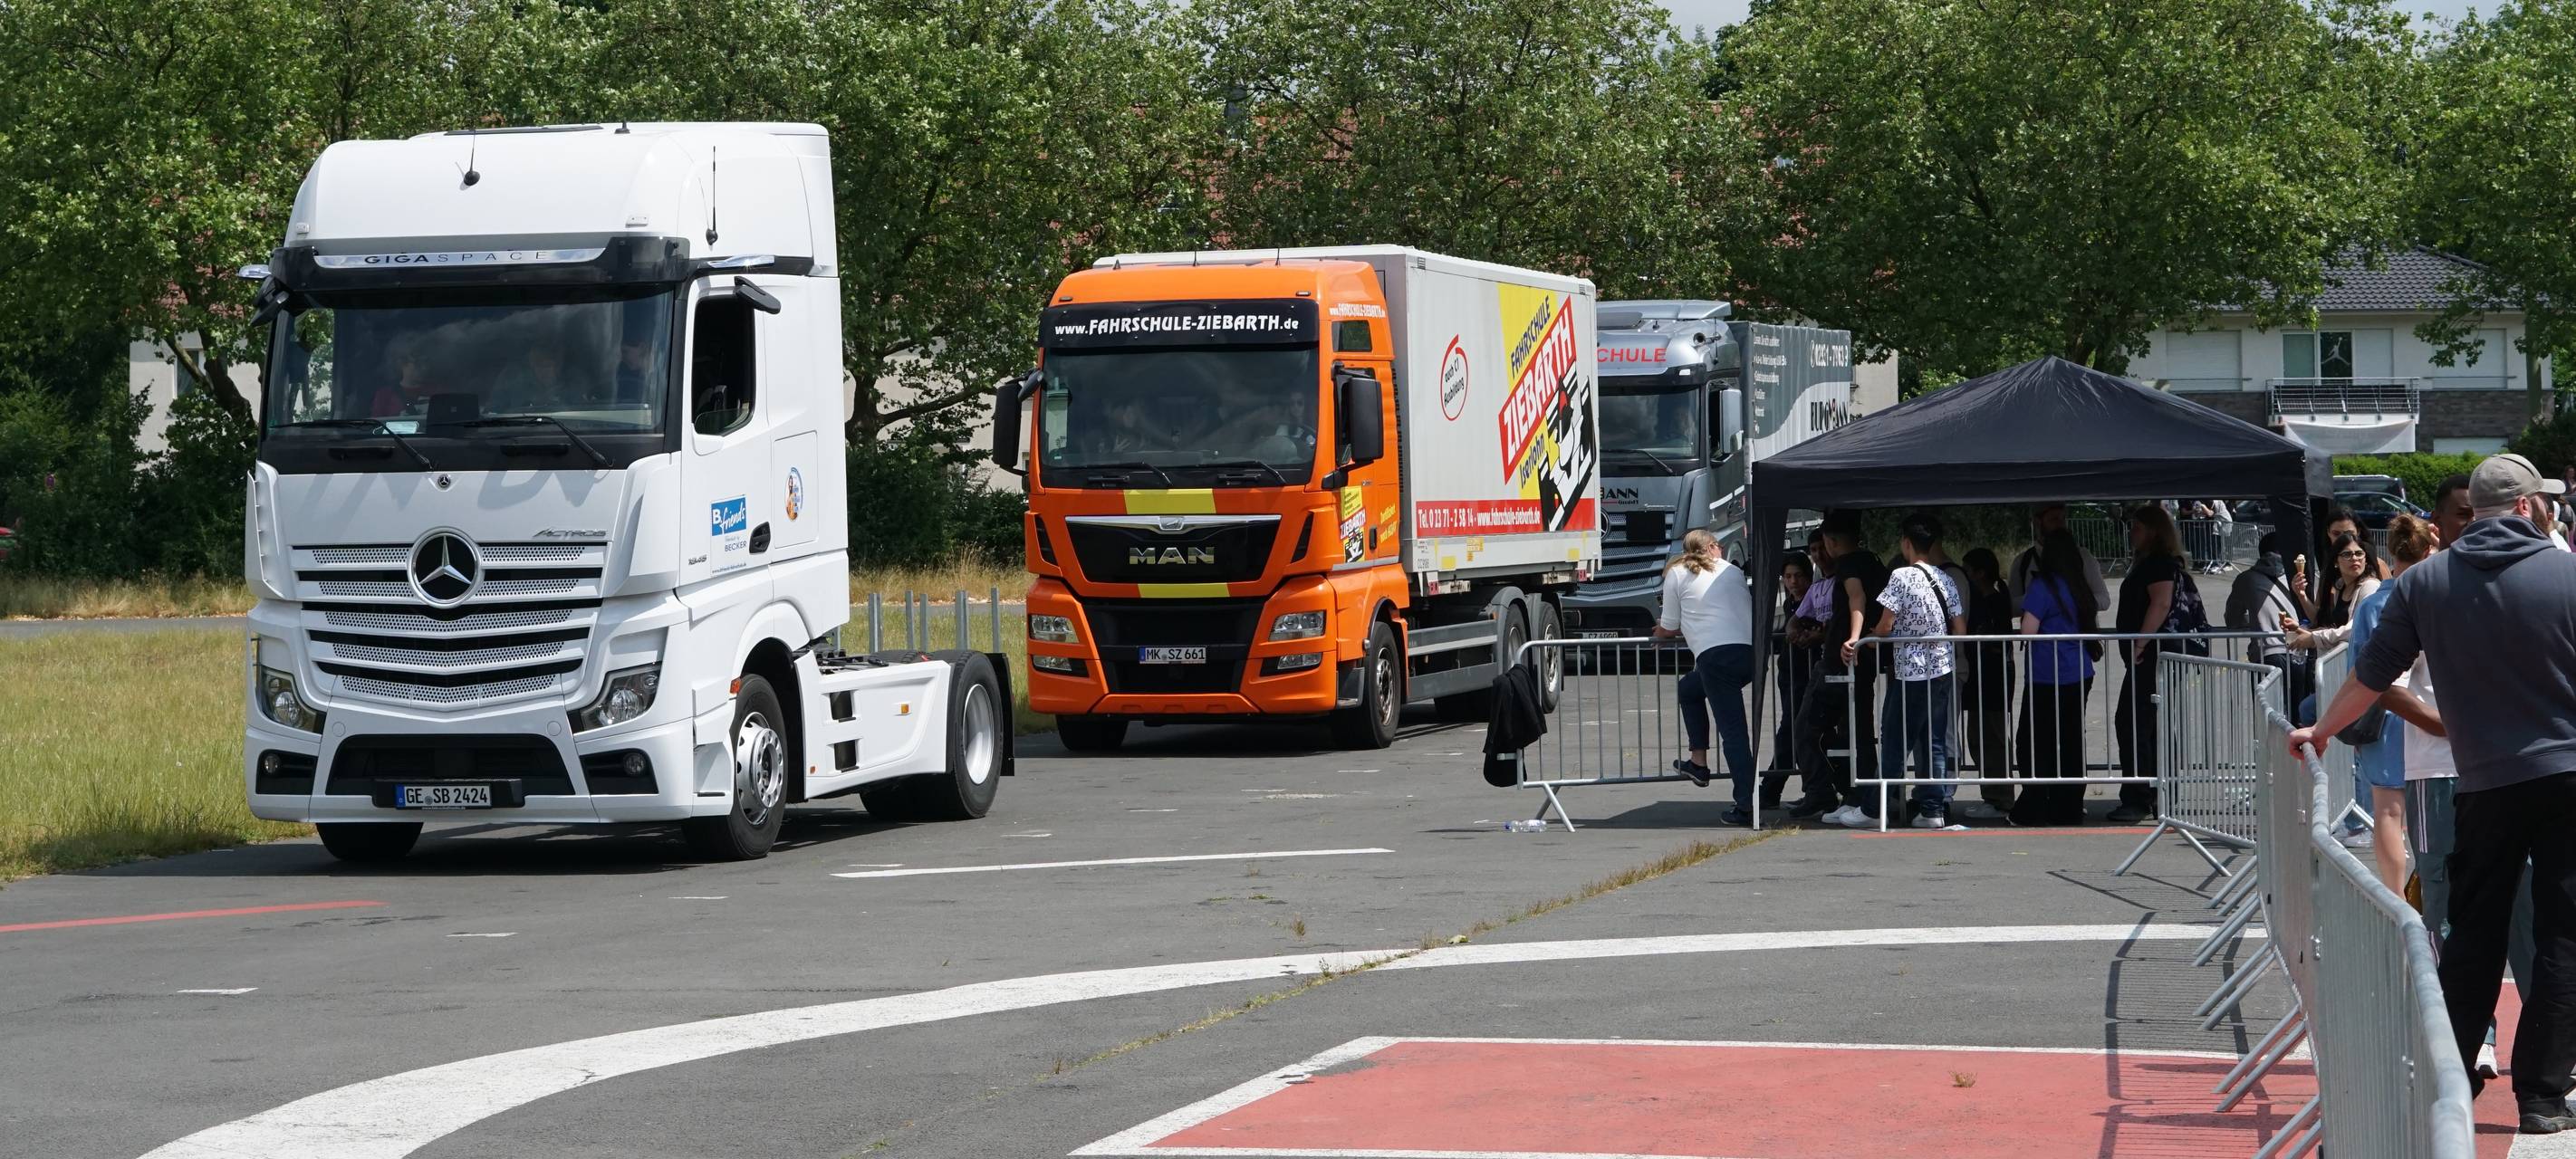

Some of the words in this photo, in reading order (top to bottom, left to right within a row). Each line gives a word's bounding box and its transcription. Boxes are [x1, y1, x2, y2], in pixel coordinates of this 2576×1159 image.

[1055, 315, 1299, 336] www.FAHRSCHULE-ZIEBARTH.de
[1510, 294, 1551, 380] FAHRSCHULE
[1504, 307, 1572, 465] ZIEBARTH
[1520, 433, 1545, 490] Iserlohn
[1418, 509, 1428, 528] Tel.
[1428, 509, 1433, 528] 0
[1434, 509, 1442, 528] 23
[1442, 508, 1449, 528] 71
[1454, 508, 1457, 527] 2
[1458, 508, 1466, 528] 58
[1466, 508, 1474, 527] 14
[725, 540, 747, 552] BECKER
[1129, 547, 1215, 565] MAN
[1147, 648, 1161, 660] MK
[1168, 648, 1182, 660] SZ
[1185, 648, 1205, 660] 661
[406, 788, 424, 804] GE
[433, 788, 450, 804] SB
[453, 788, 487, 804] 2424
